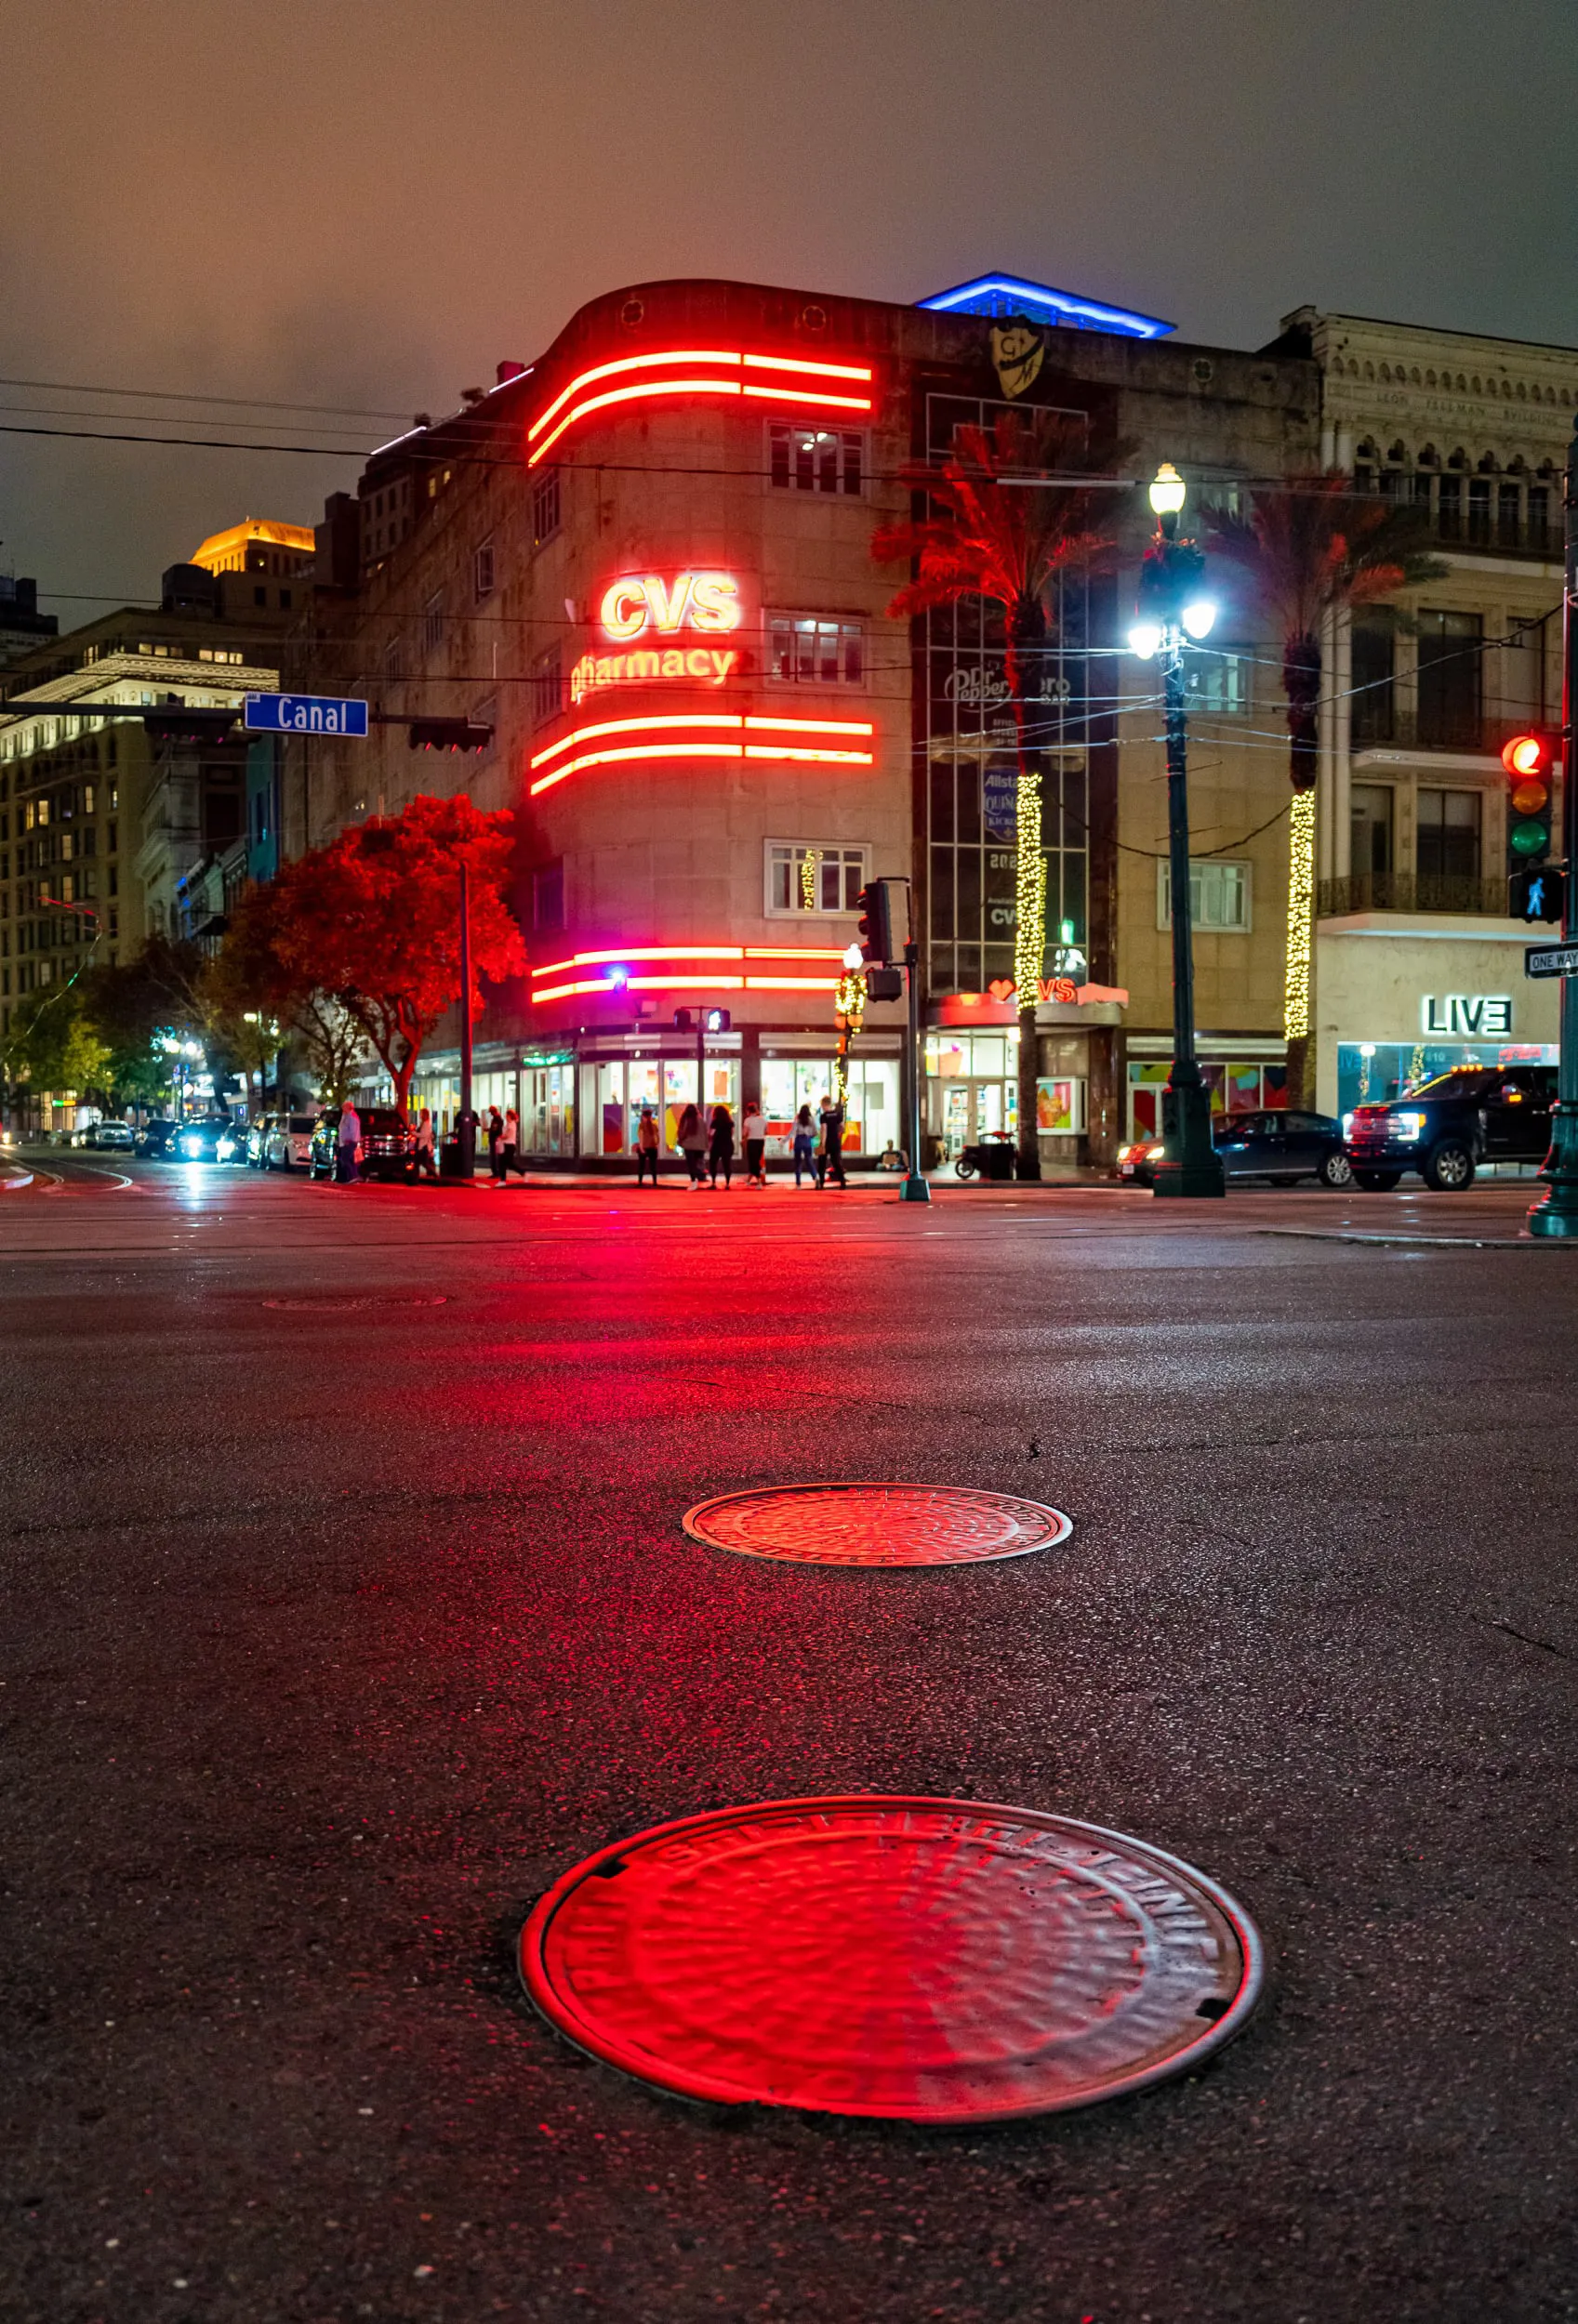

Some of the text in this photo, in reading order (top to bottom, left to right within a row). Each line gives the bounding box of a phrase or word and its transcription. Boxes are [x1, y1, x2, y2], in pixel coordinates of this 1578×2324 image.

[601, 573, 743, 639] CVS
[570, 649, 736, 705] pharmacy
[955, 669, 1070, 707] Pepper ro
[970, 667, 995, 688] Dr
[278, 697, 346, 733] Canal
[990, 908, 1017, 926] CV
[1532, 951, 1578, 969] ONE WAY
[1035, 978, 1076, 1003] VS
